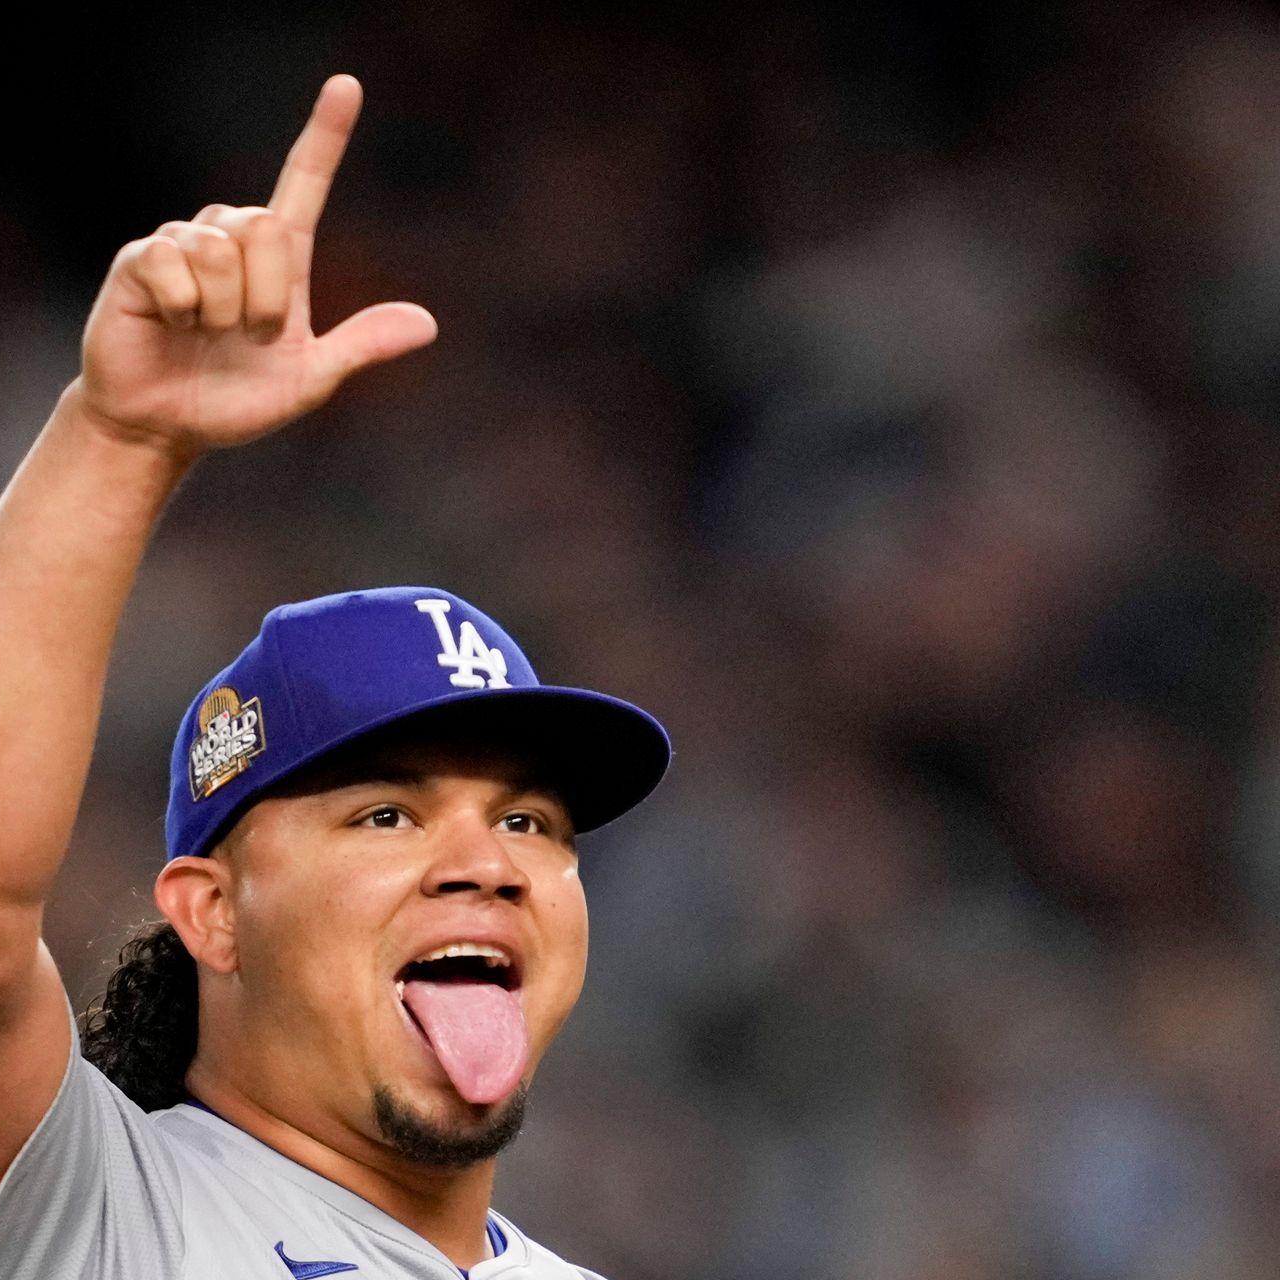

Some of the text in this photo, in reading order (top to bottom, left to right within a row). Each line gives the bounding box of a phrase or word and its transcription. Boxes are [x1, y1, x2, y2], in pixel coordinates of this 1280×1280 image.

[414, 599, 512, 689] LA
[192, 710, 258, 766] WORLD
[195, 728, 257, 785] SERIES
